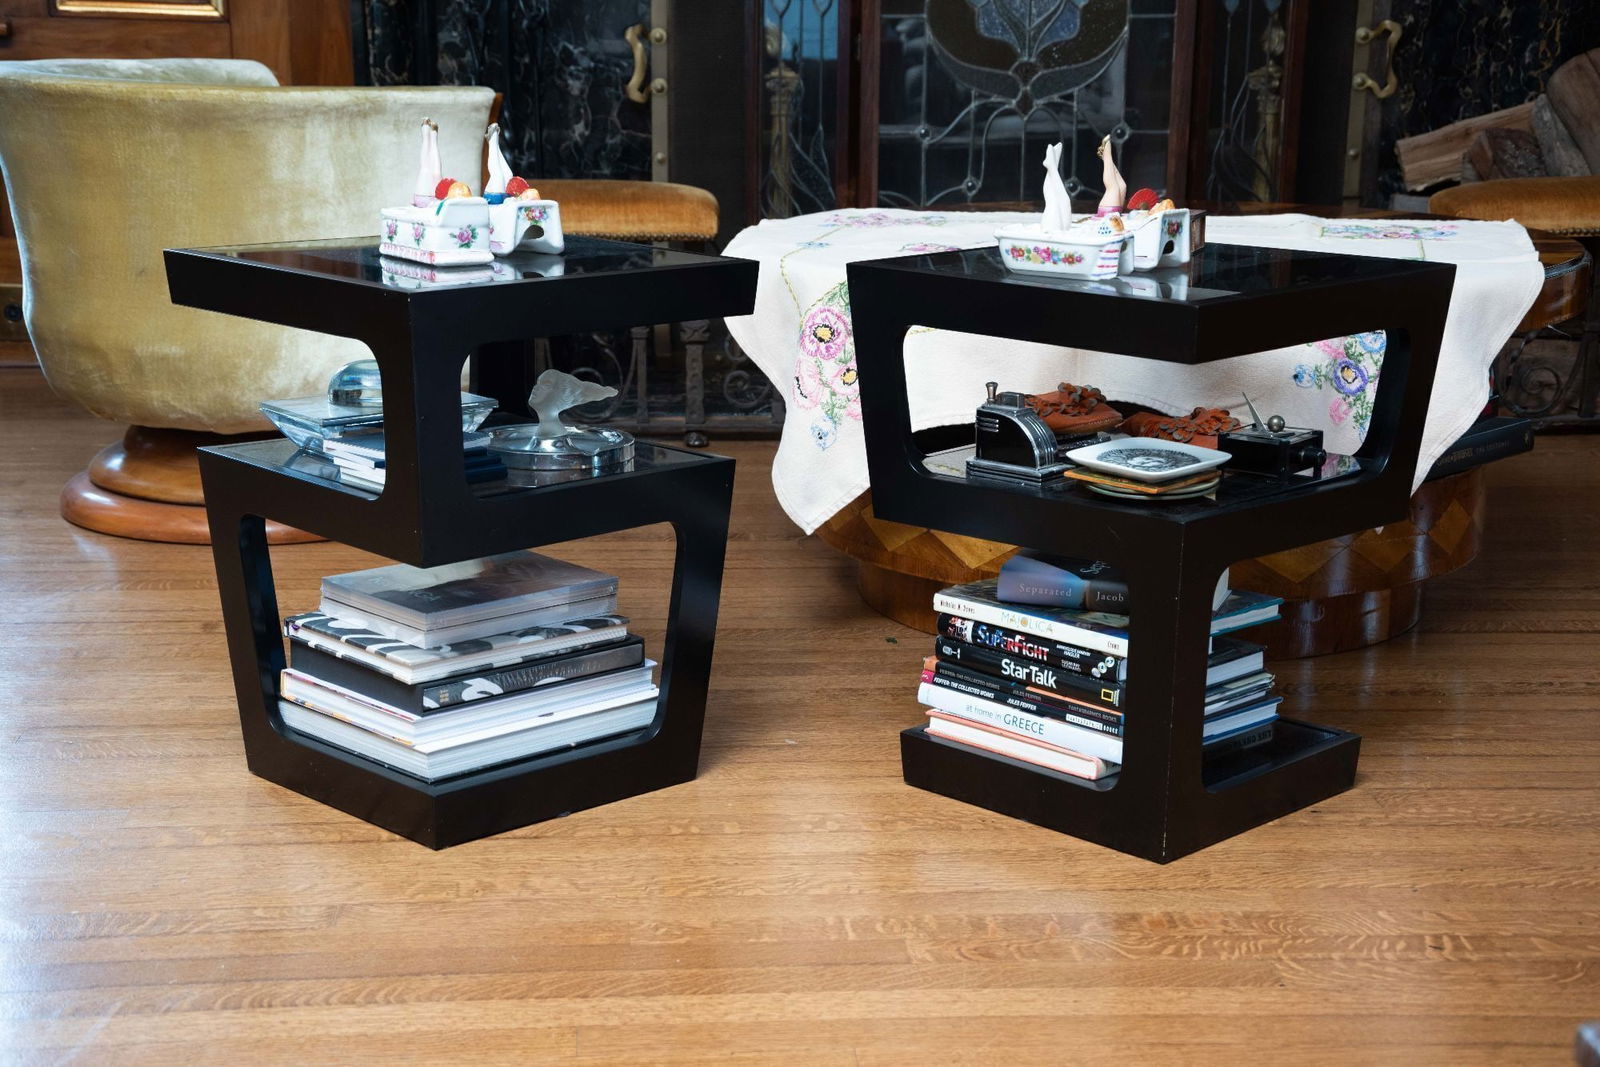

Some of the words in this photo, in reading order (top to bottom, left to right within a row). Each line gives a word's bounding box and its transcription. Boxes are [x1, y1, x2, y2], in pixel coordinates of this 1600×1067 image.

[1019, 584, 1072, 597] Separated
[1096, 591, 1124, 602] Jacob
[1001, 612, 1053, 632] MAJOLICA
[1001, 658, 1057, 689] StarTalk
[974, 706, 994, 718] home
[1003, 713, 1045, 735] GREECE
